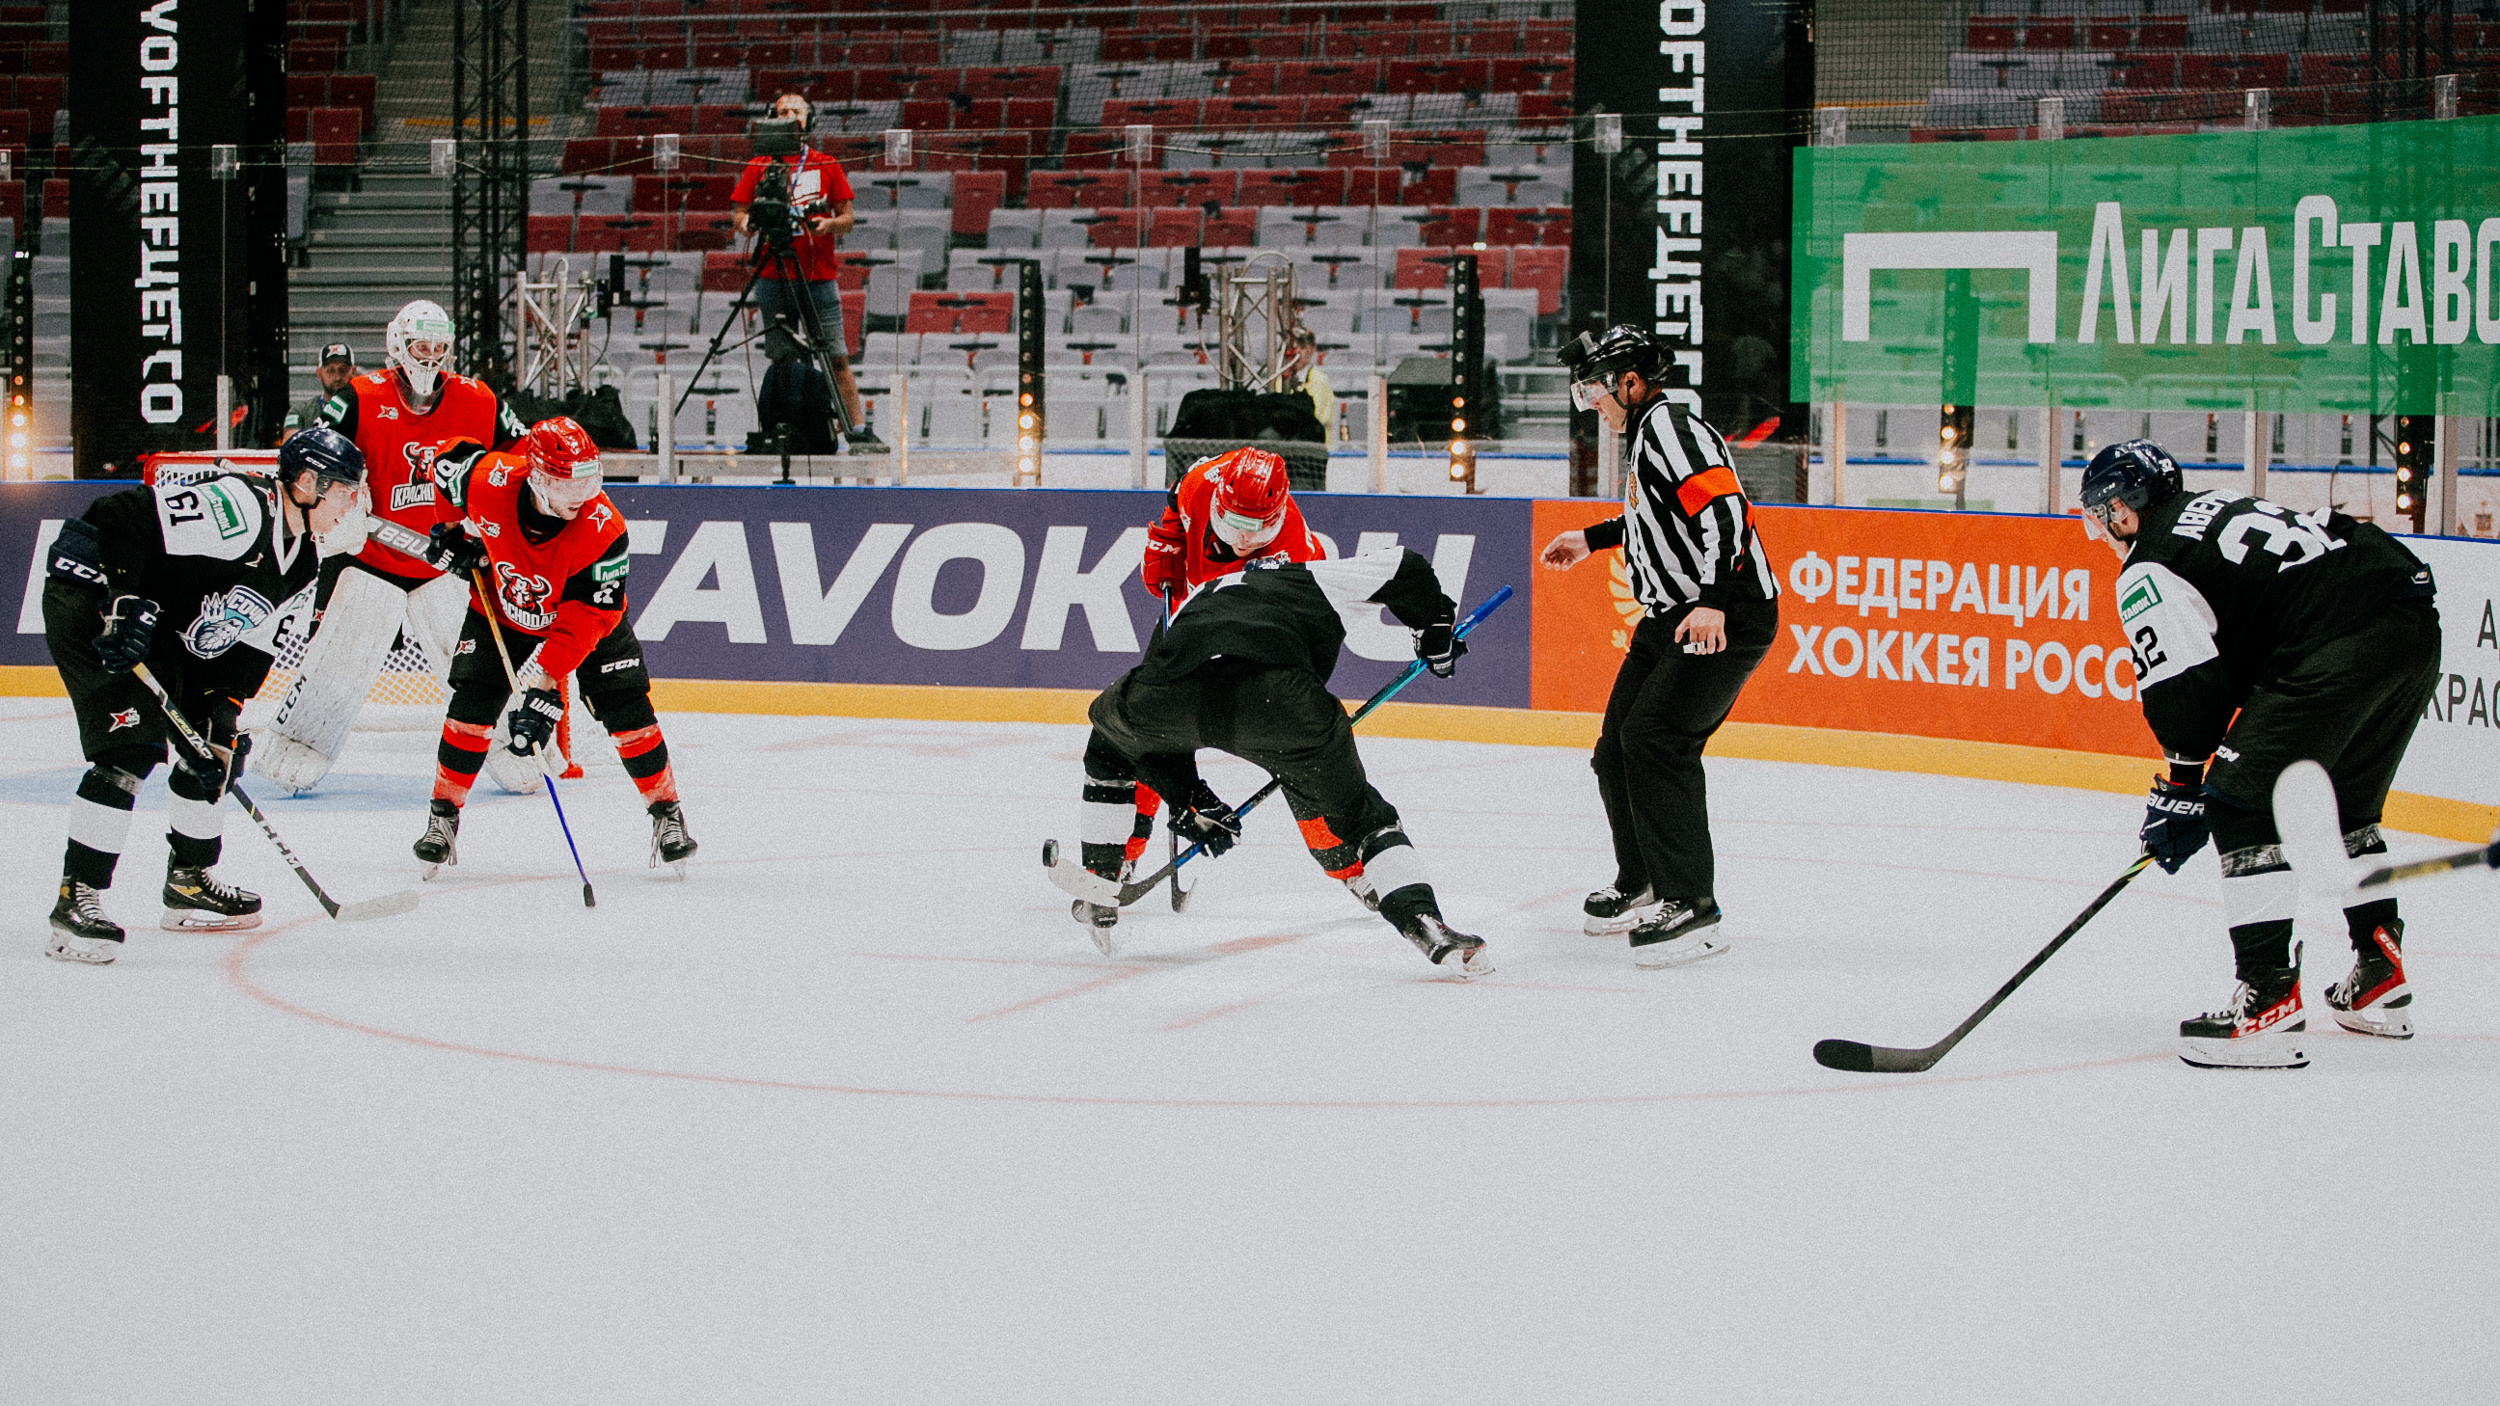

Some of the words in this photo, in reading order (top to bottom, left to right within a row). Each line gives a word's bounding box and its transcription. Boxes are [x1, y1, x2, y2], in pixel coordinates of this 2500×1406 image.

[2077, 201, 2277, 345] ЛИГА
[1789, 551, 2090, 627] ФЕДЕРАЦИЯ
[600, 657, 641, 675] CCM
[1787, 624, 1989, 687] ХОККЕЯ
[2005, 639, 2143, 702] РОСС
[275, 675, 308, 726] CCM
[2237, 998, 2297, 1038] CCM
